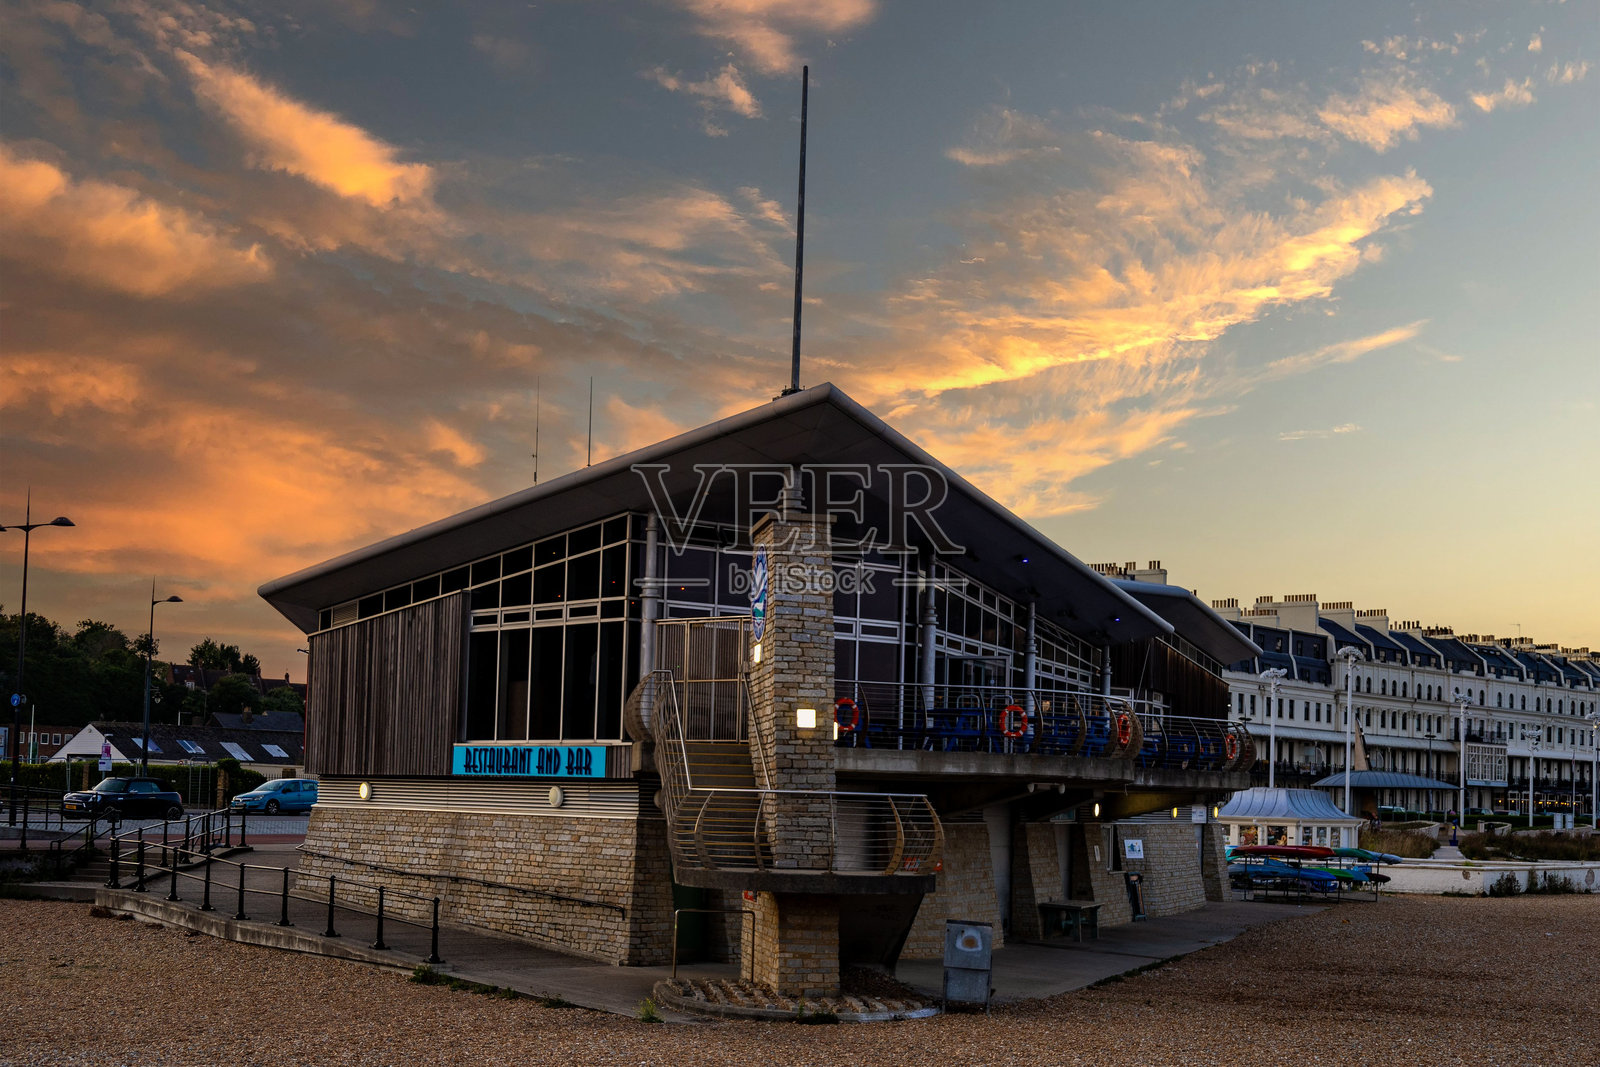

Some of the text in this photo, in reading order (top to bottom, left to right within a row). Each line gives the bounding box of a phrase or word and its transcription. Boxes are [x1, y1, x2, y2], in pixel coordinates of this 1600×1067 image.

[464, 747, 592, 776] RESTAURANT AND BAR
